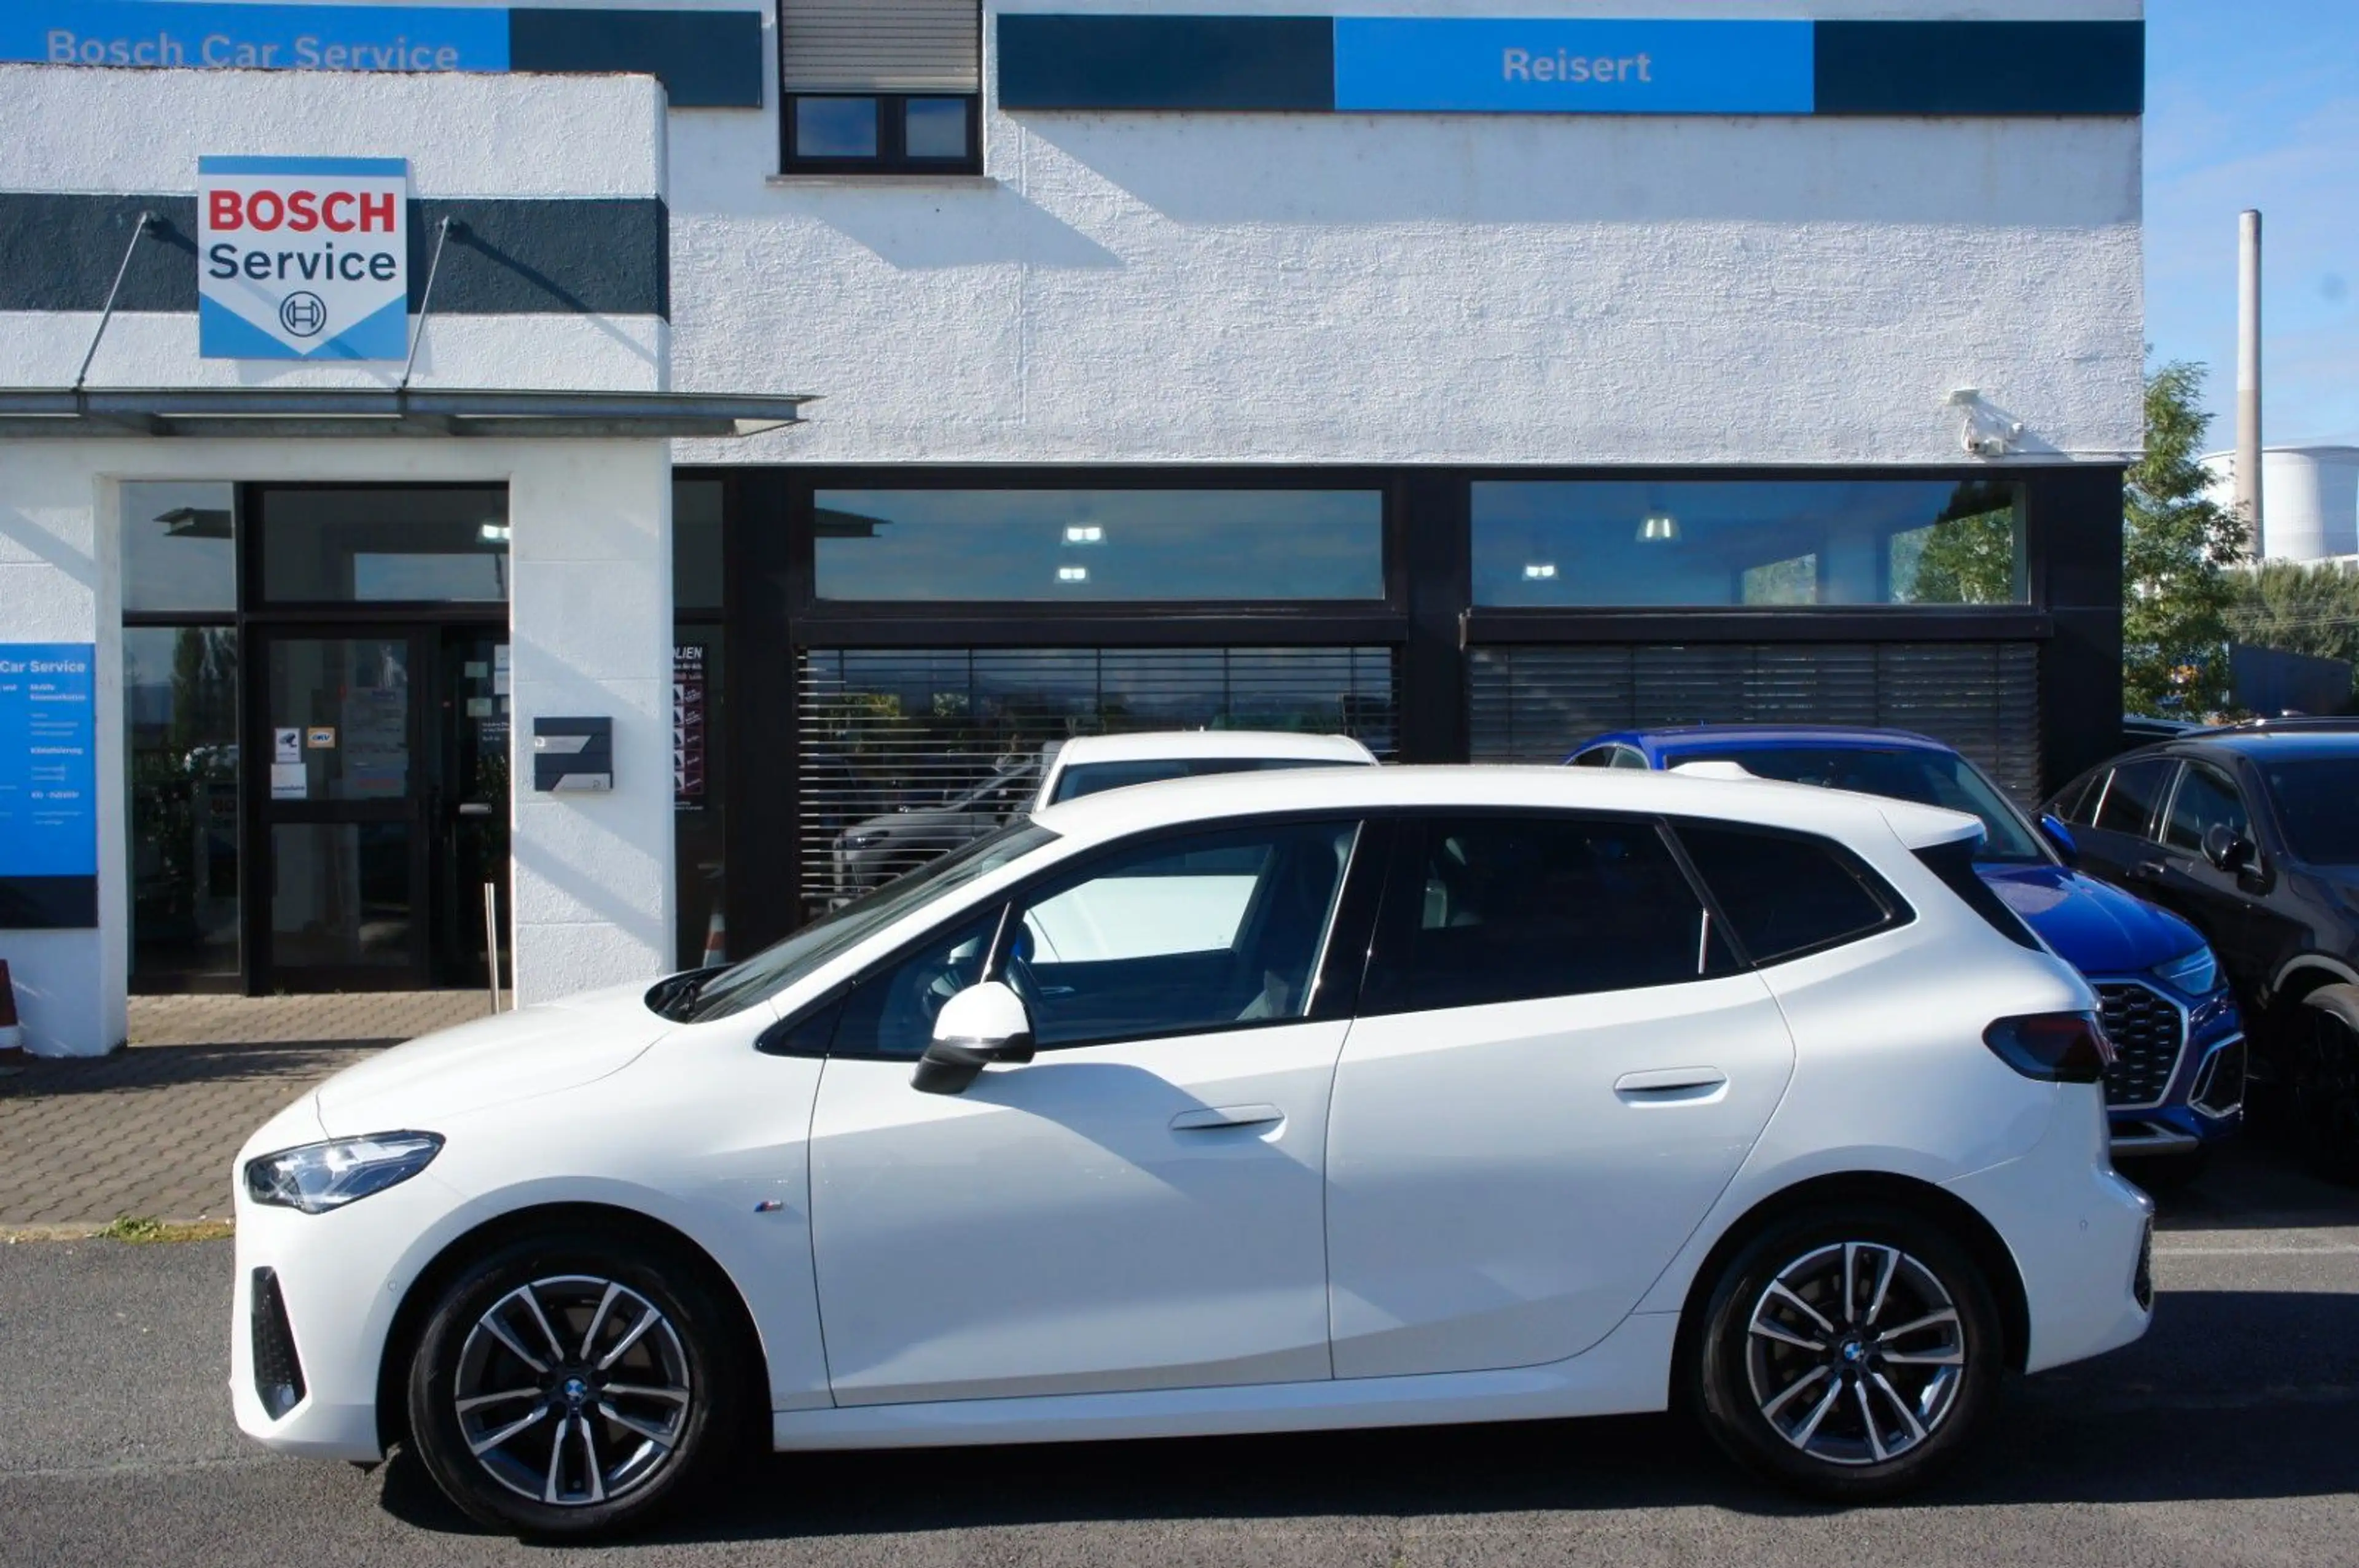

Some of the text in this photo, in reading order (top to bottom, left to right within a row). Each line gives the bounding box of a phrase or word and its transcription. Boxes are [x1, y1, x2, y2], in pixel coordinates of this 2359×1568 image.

[48, 29, 458, 71] Bosch Car Service
[1503, 47, 1652, 82] Reisert
[209, 190, 394, 232] BOSCH
[208, 241, 396, 281] Service
[0, 660, 85, 673] Car Service
[673, 647, 702, 659] LIEN
